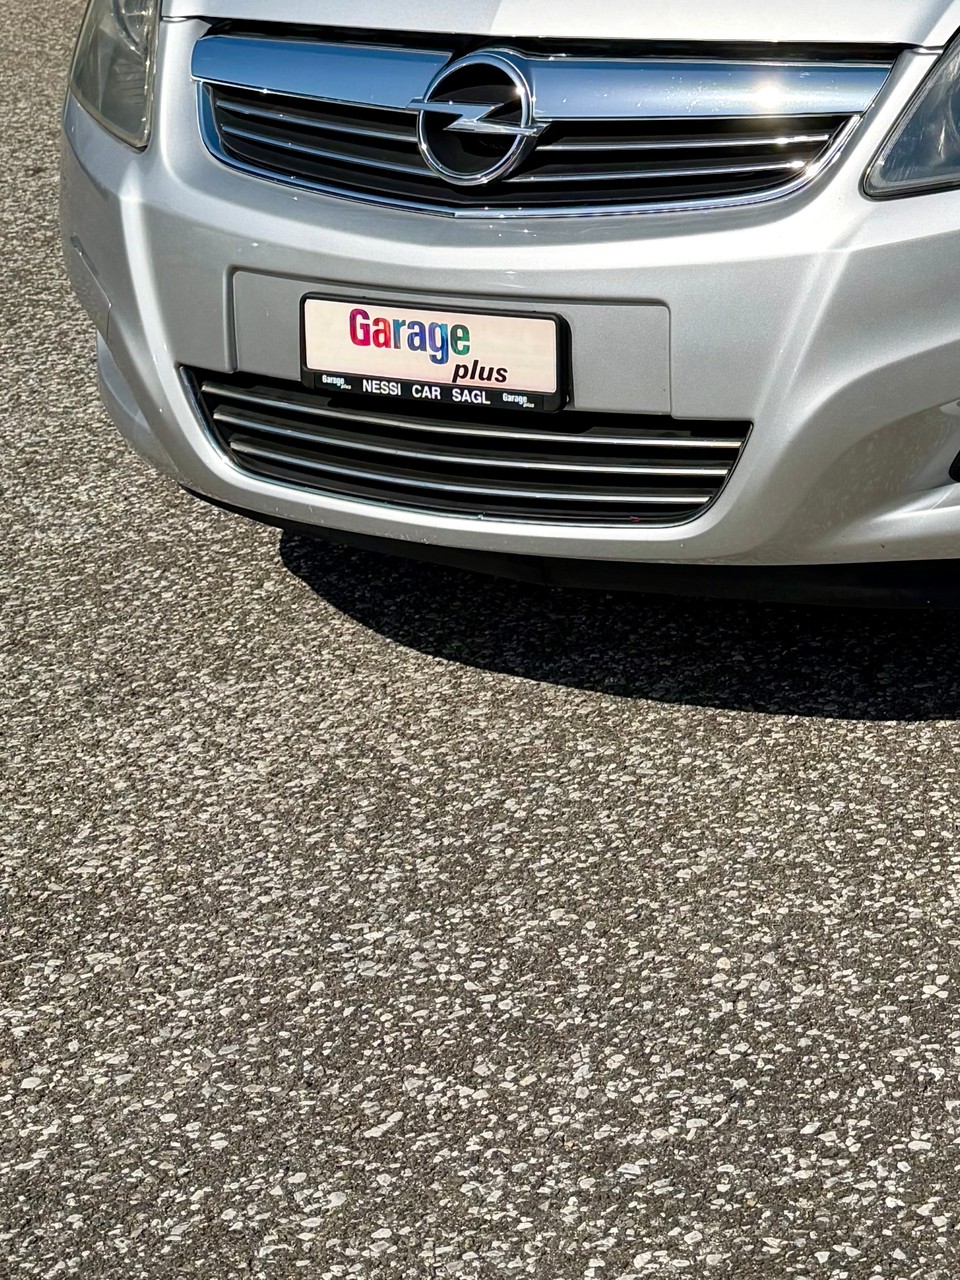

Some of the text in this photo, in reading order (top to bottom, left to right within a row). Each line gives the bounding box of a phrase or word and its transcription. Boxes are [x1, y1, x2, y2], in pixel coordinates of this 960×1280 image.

[349, 308, 471, 365] Garage
[321, 375, 346, 387] Garage
[452, 359, 508, 383] plus
[362, 379, 491, 404] NESSI CAR SAGL
[502, 393, 528, 405] Garage
